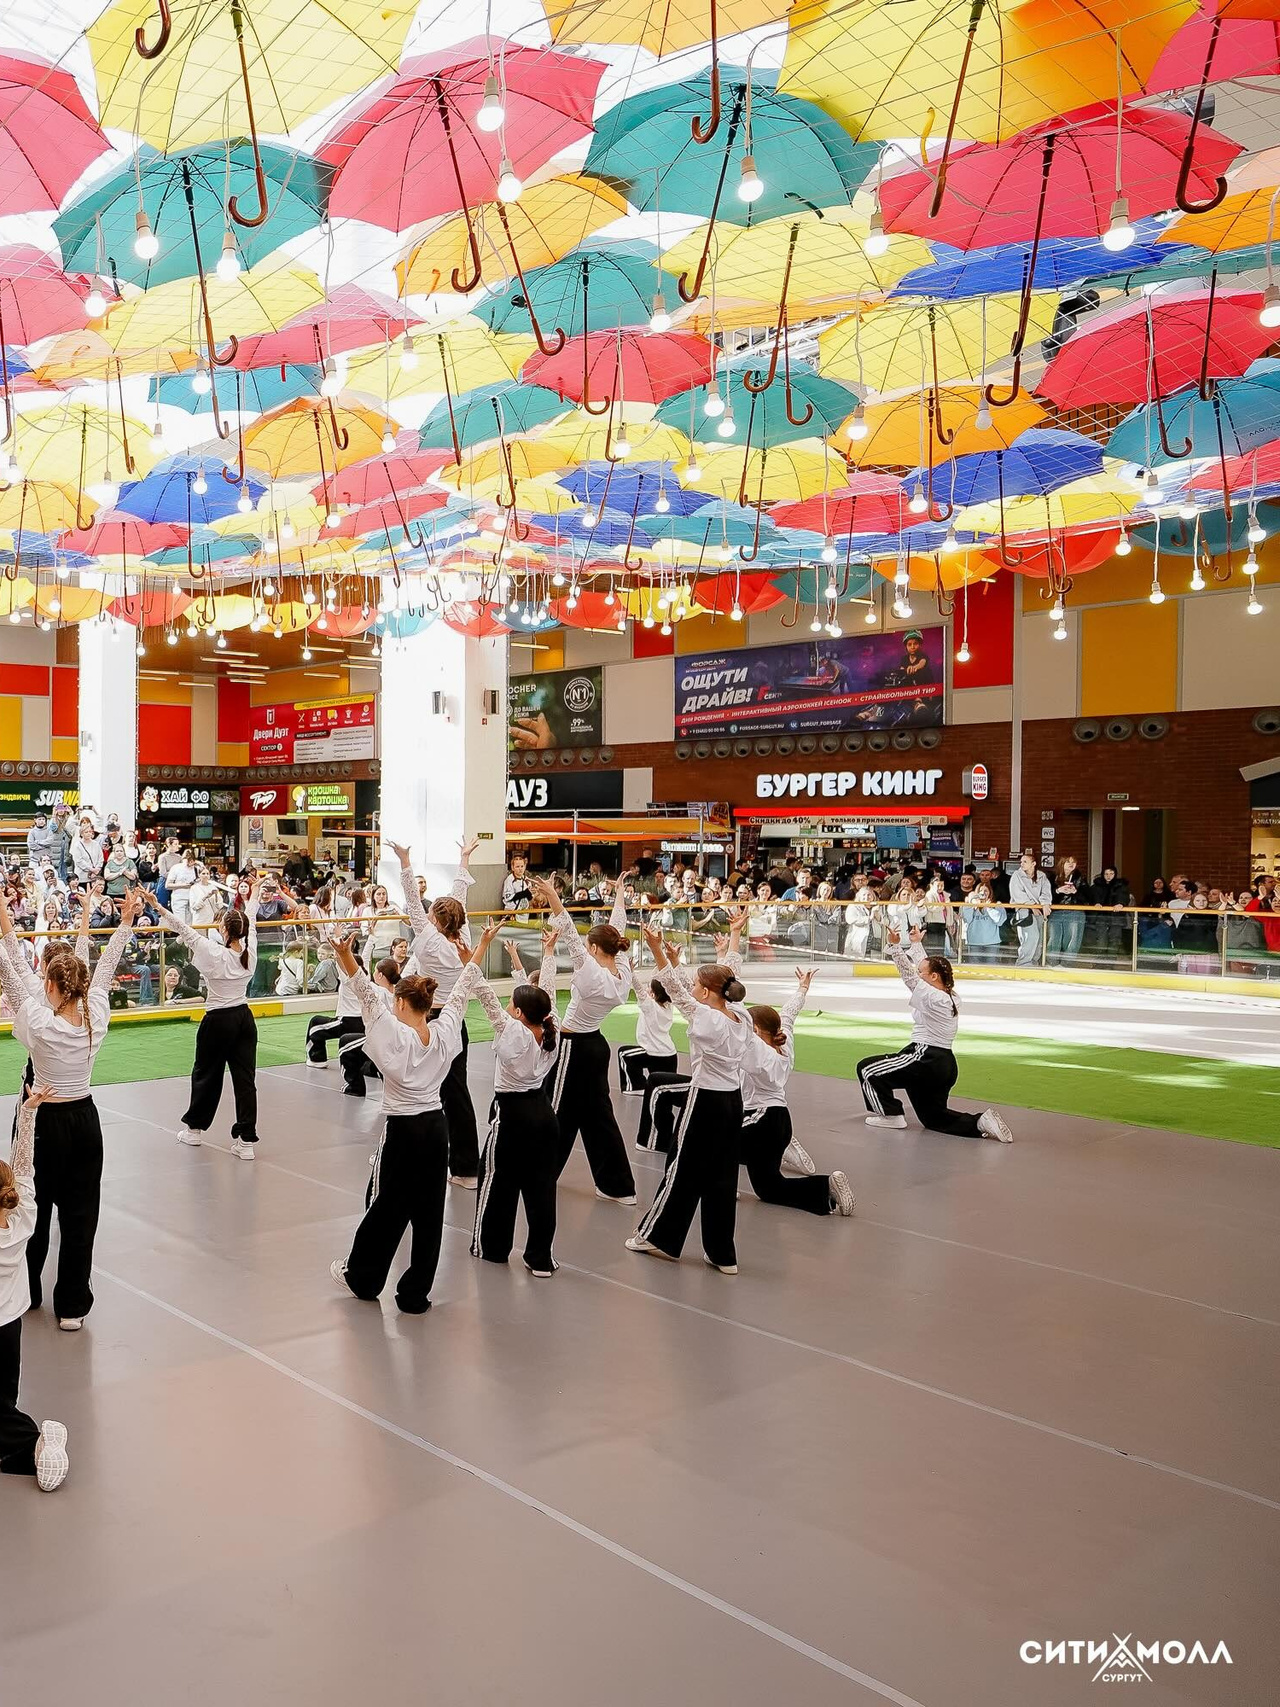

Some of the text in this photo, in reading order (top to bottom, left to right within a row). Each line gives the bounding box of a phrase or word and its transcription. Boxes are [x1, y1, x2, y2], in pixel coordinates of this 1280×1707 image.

[690, 657, 727, 667] ФОРСАЖ
[681, 667, 748, 691] ОЩУТИ
[681, 687, 754, 714] ДРАЙВ!
[731, 702, 782, 717] ИНТЕРАКТИВНЫЙ
[782, 699, 823, 711] АЭРОХОККЕЙ
[859, 689, 920, 702] СТРАЙКБОЛЬНЫЙ
[921, 687, 937, 695] ТИР
[253, 727, 289, 741] Двери Дуэт
[756, 769, 943, 798] БУРГЕР КИНГ
[973, 783, 986, 791] KING
[160, 787, 210, 804] ХАЙ ФО
[749, 817, 781, 825] Скидки
[792, 816, 811, 825] 40%
[861, 817, 910, 825] приложении
